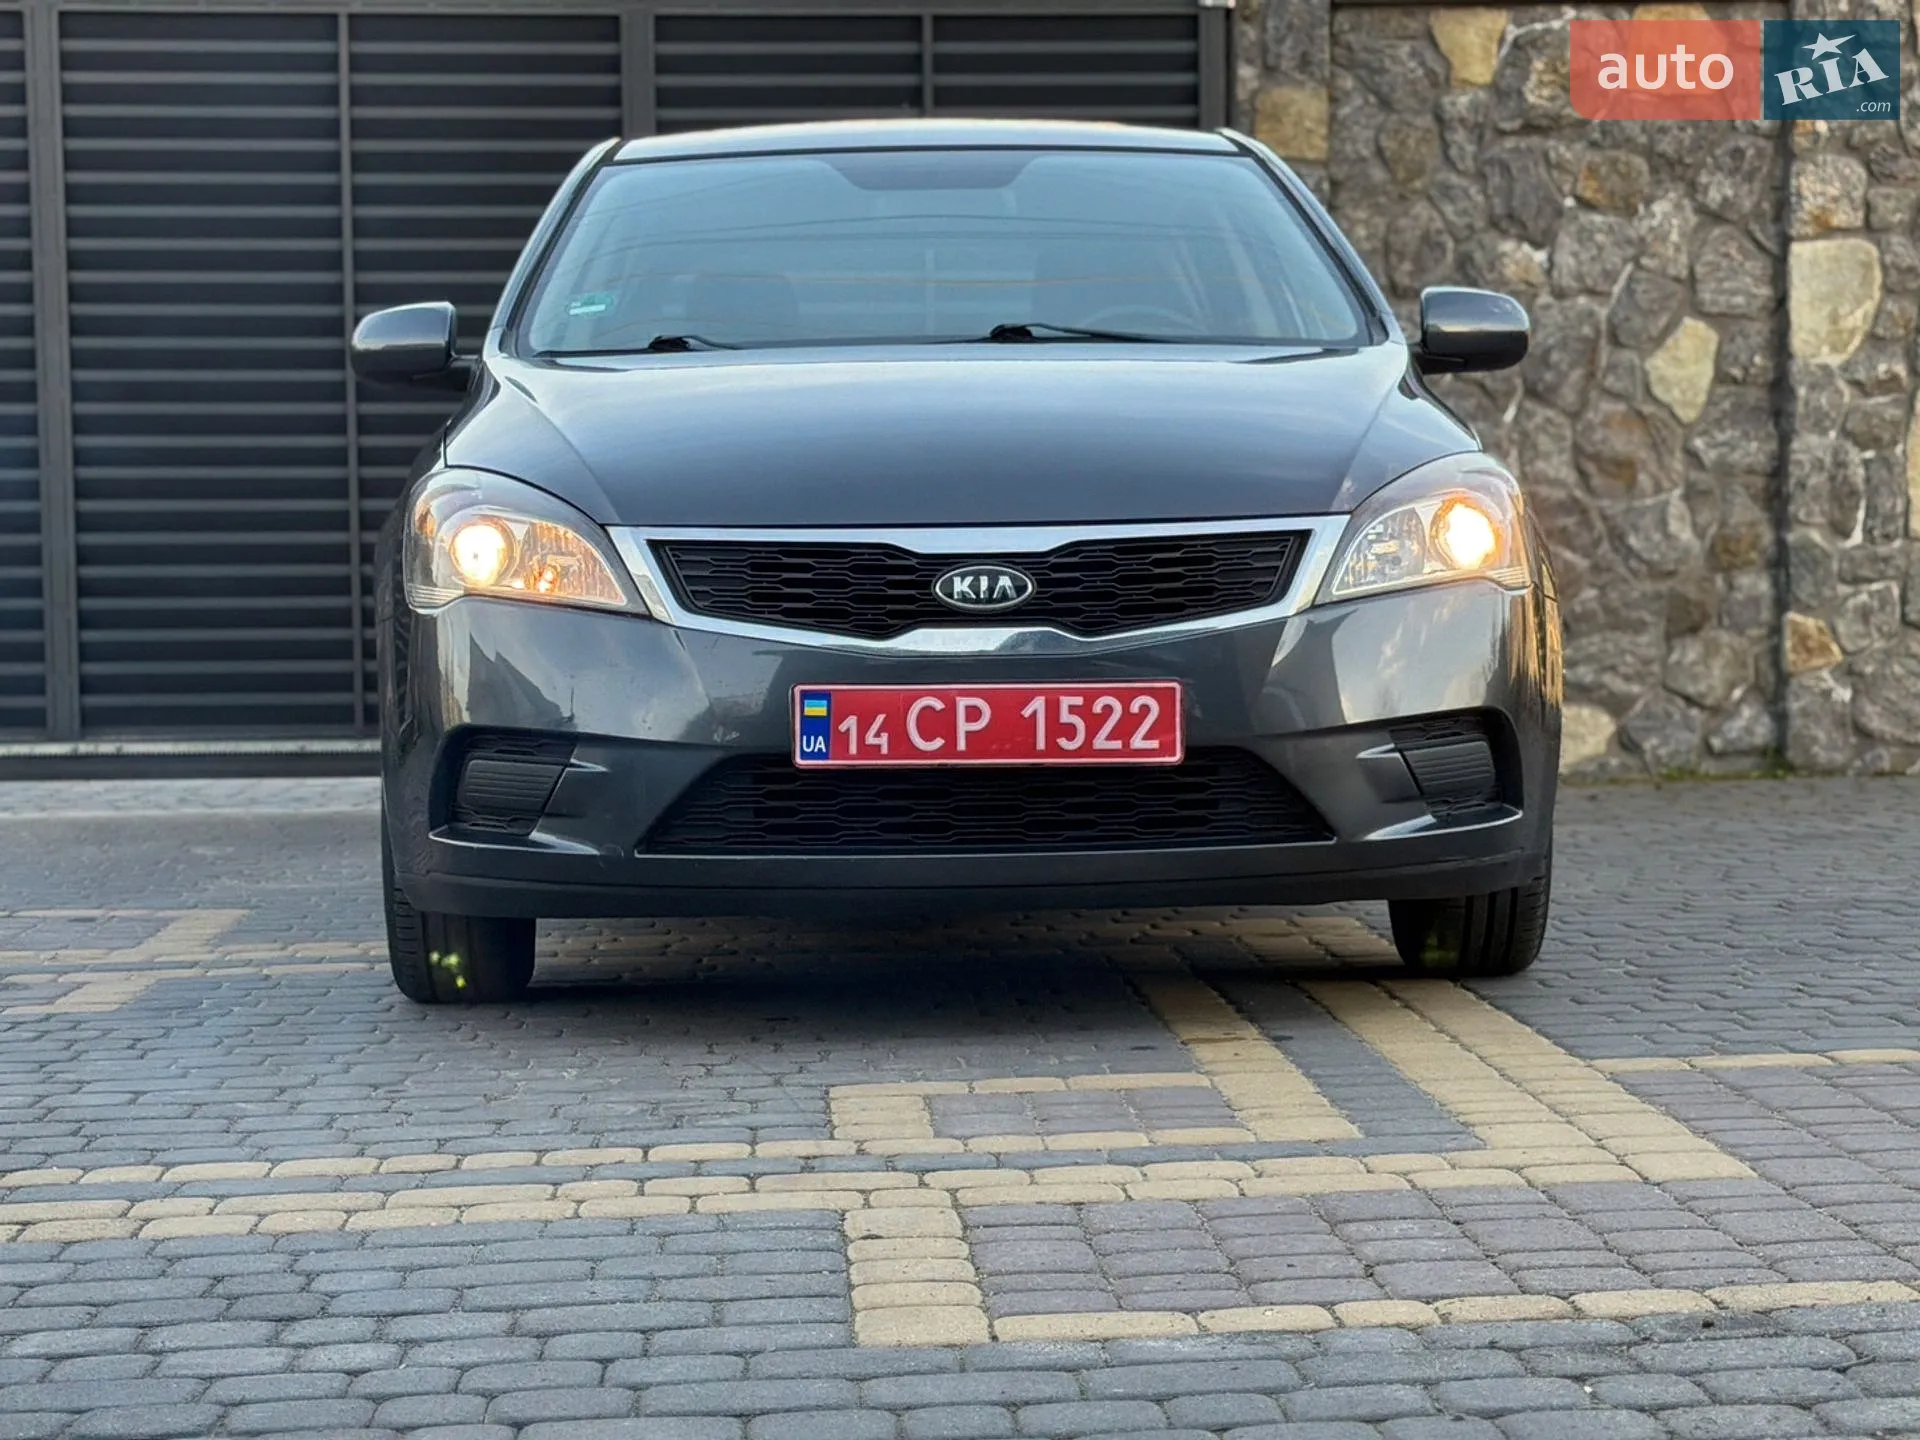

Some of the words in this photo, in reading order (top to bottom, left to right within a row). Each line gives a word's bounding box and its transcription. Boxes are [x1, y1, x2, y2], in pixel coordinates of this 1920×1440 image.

[952, 575, 1017, 599] KIA
[838, 713, 889, 755] 14
[906, 696, 992, 752] CP
[1020, 695, 1161, 752] 1522
[802, 735, 827, 753] UA
